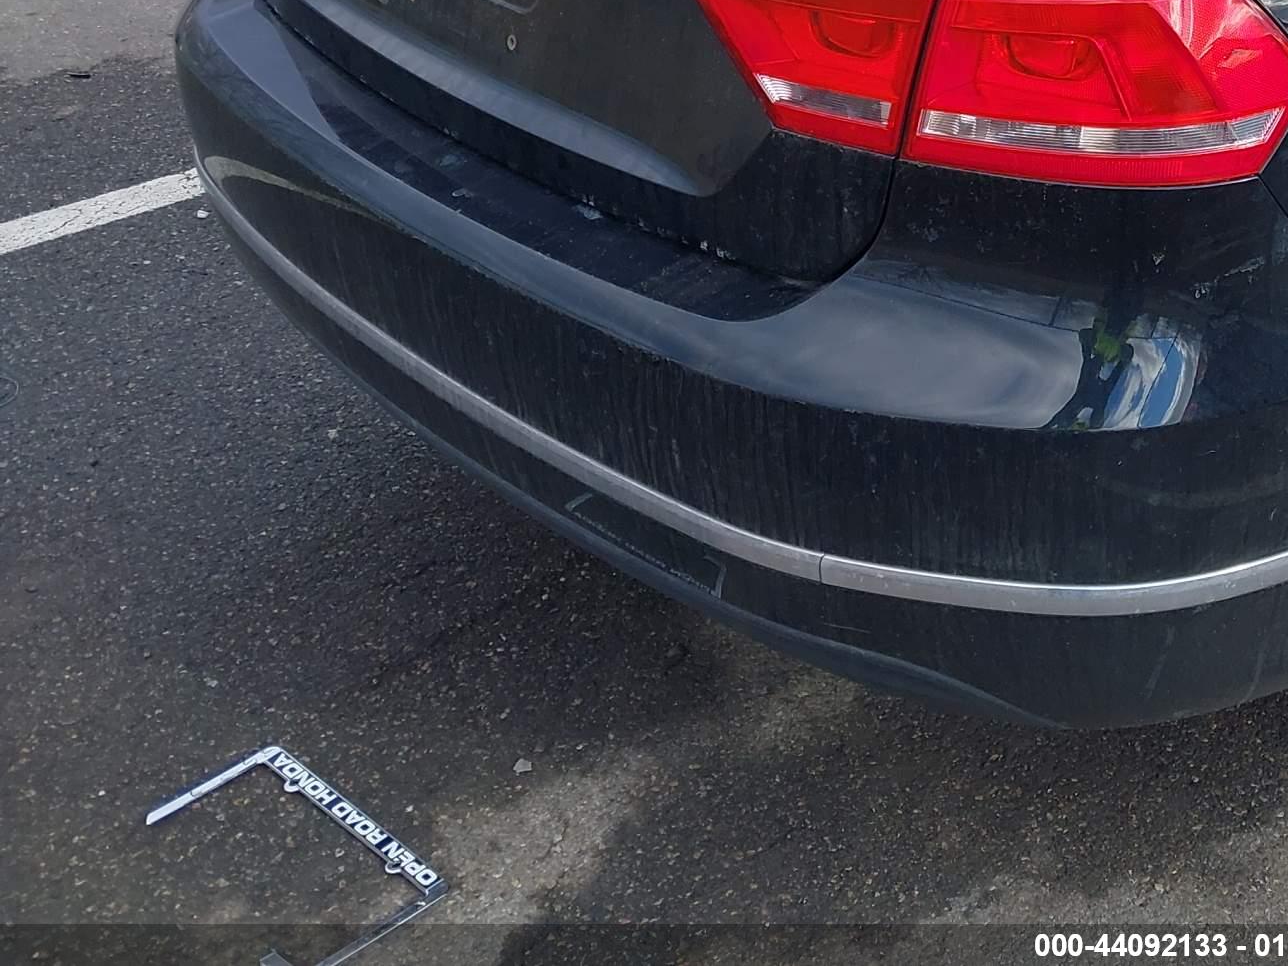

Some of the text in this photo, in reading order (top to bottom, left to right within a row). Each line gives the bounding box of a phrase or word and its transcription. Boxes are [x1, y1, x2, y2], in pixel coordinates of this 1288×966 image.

[272, 752, 438, 886] OPEN ROAD HONDA
